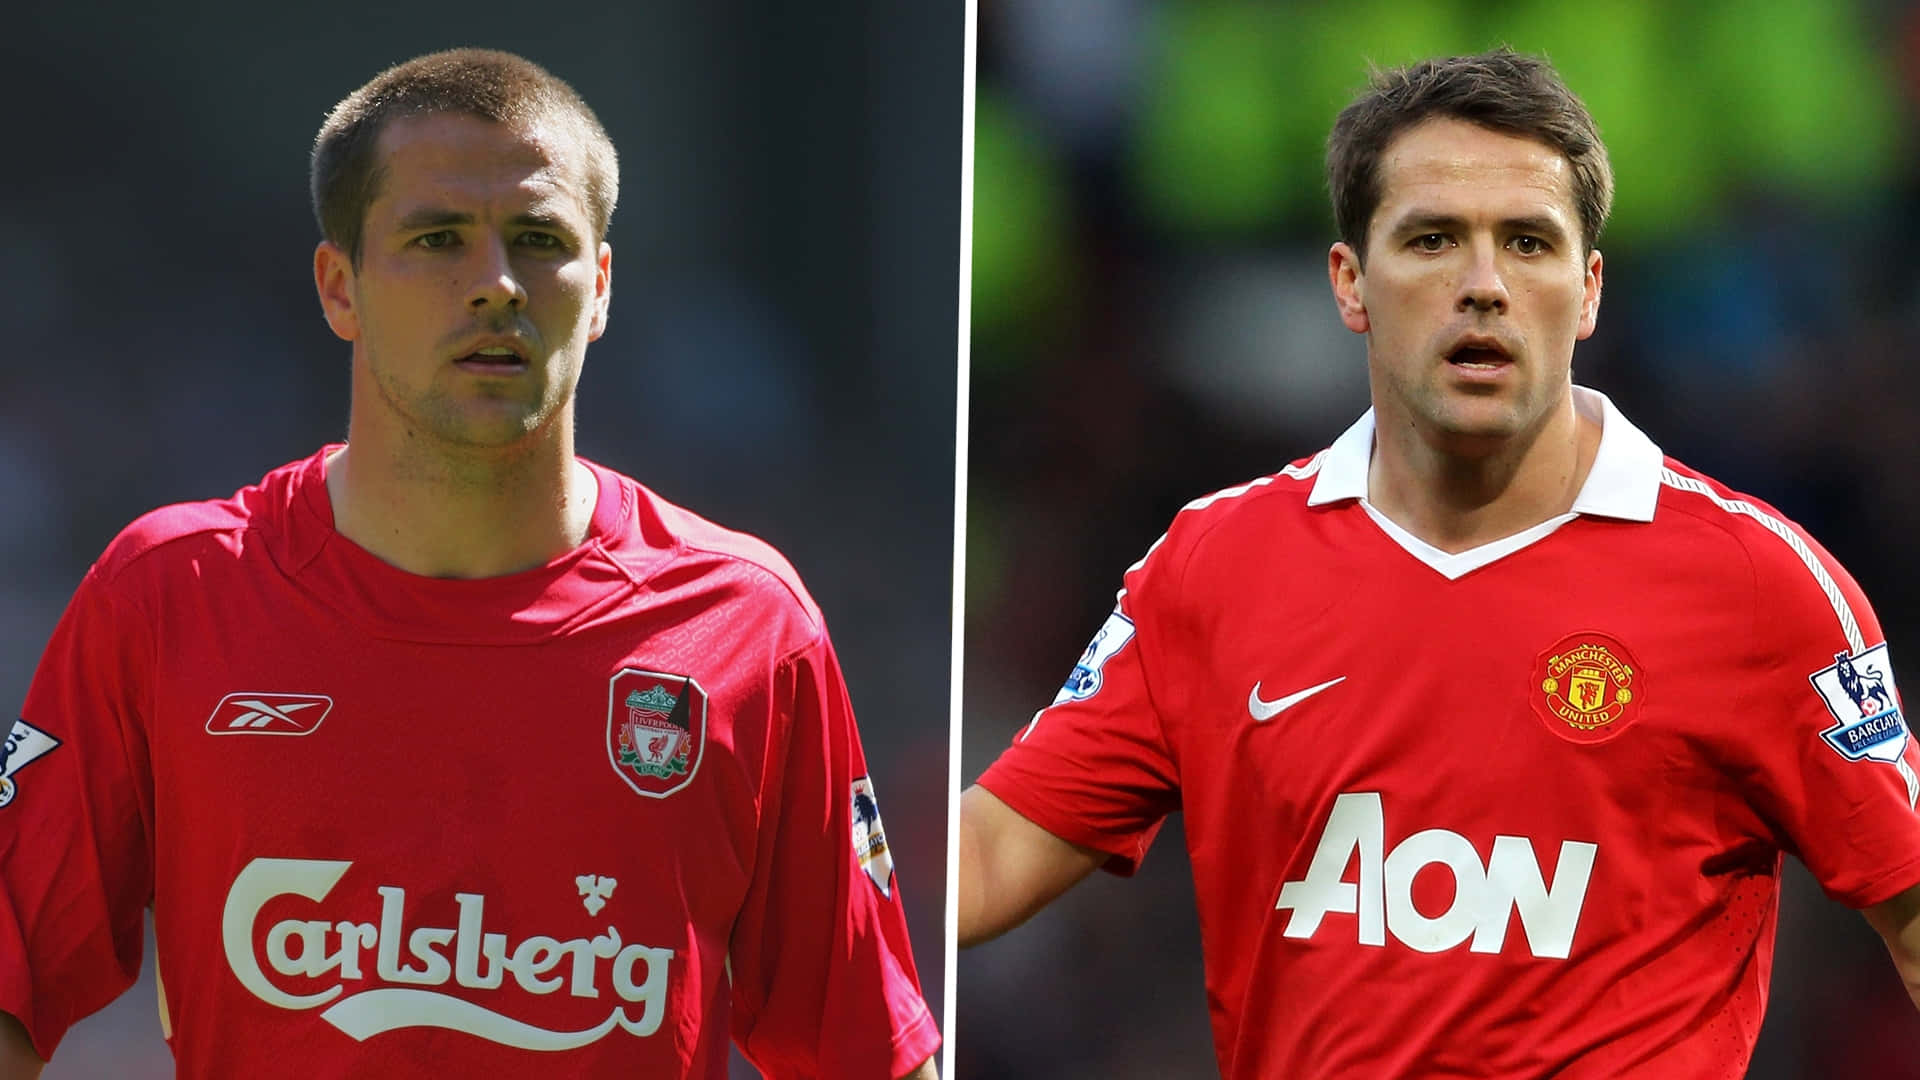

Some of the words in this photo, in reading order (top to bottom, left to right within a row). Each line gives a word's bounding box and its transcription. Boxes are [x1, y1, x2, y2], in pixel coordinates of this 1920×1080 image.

[1554, 650, 1626, 682] MANCHESTER
[1559, 706, 1609, 724] UNITED
[222, 857, 674, 1051] Carlsberg
